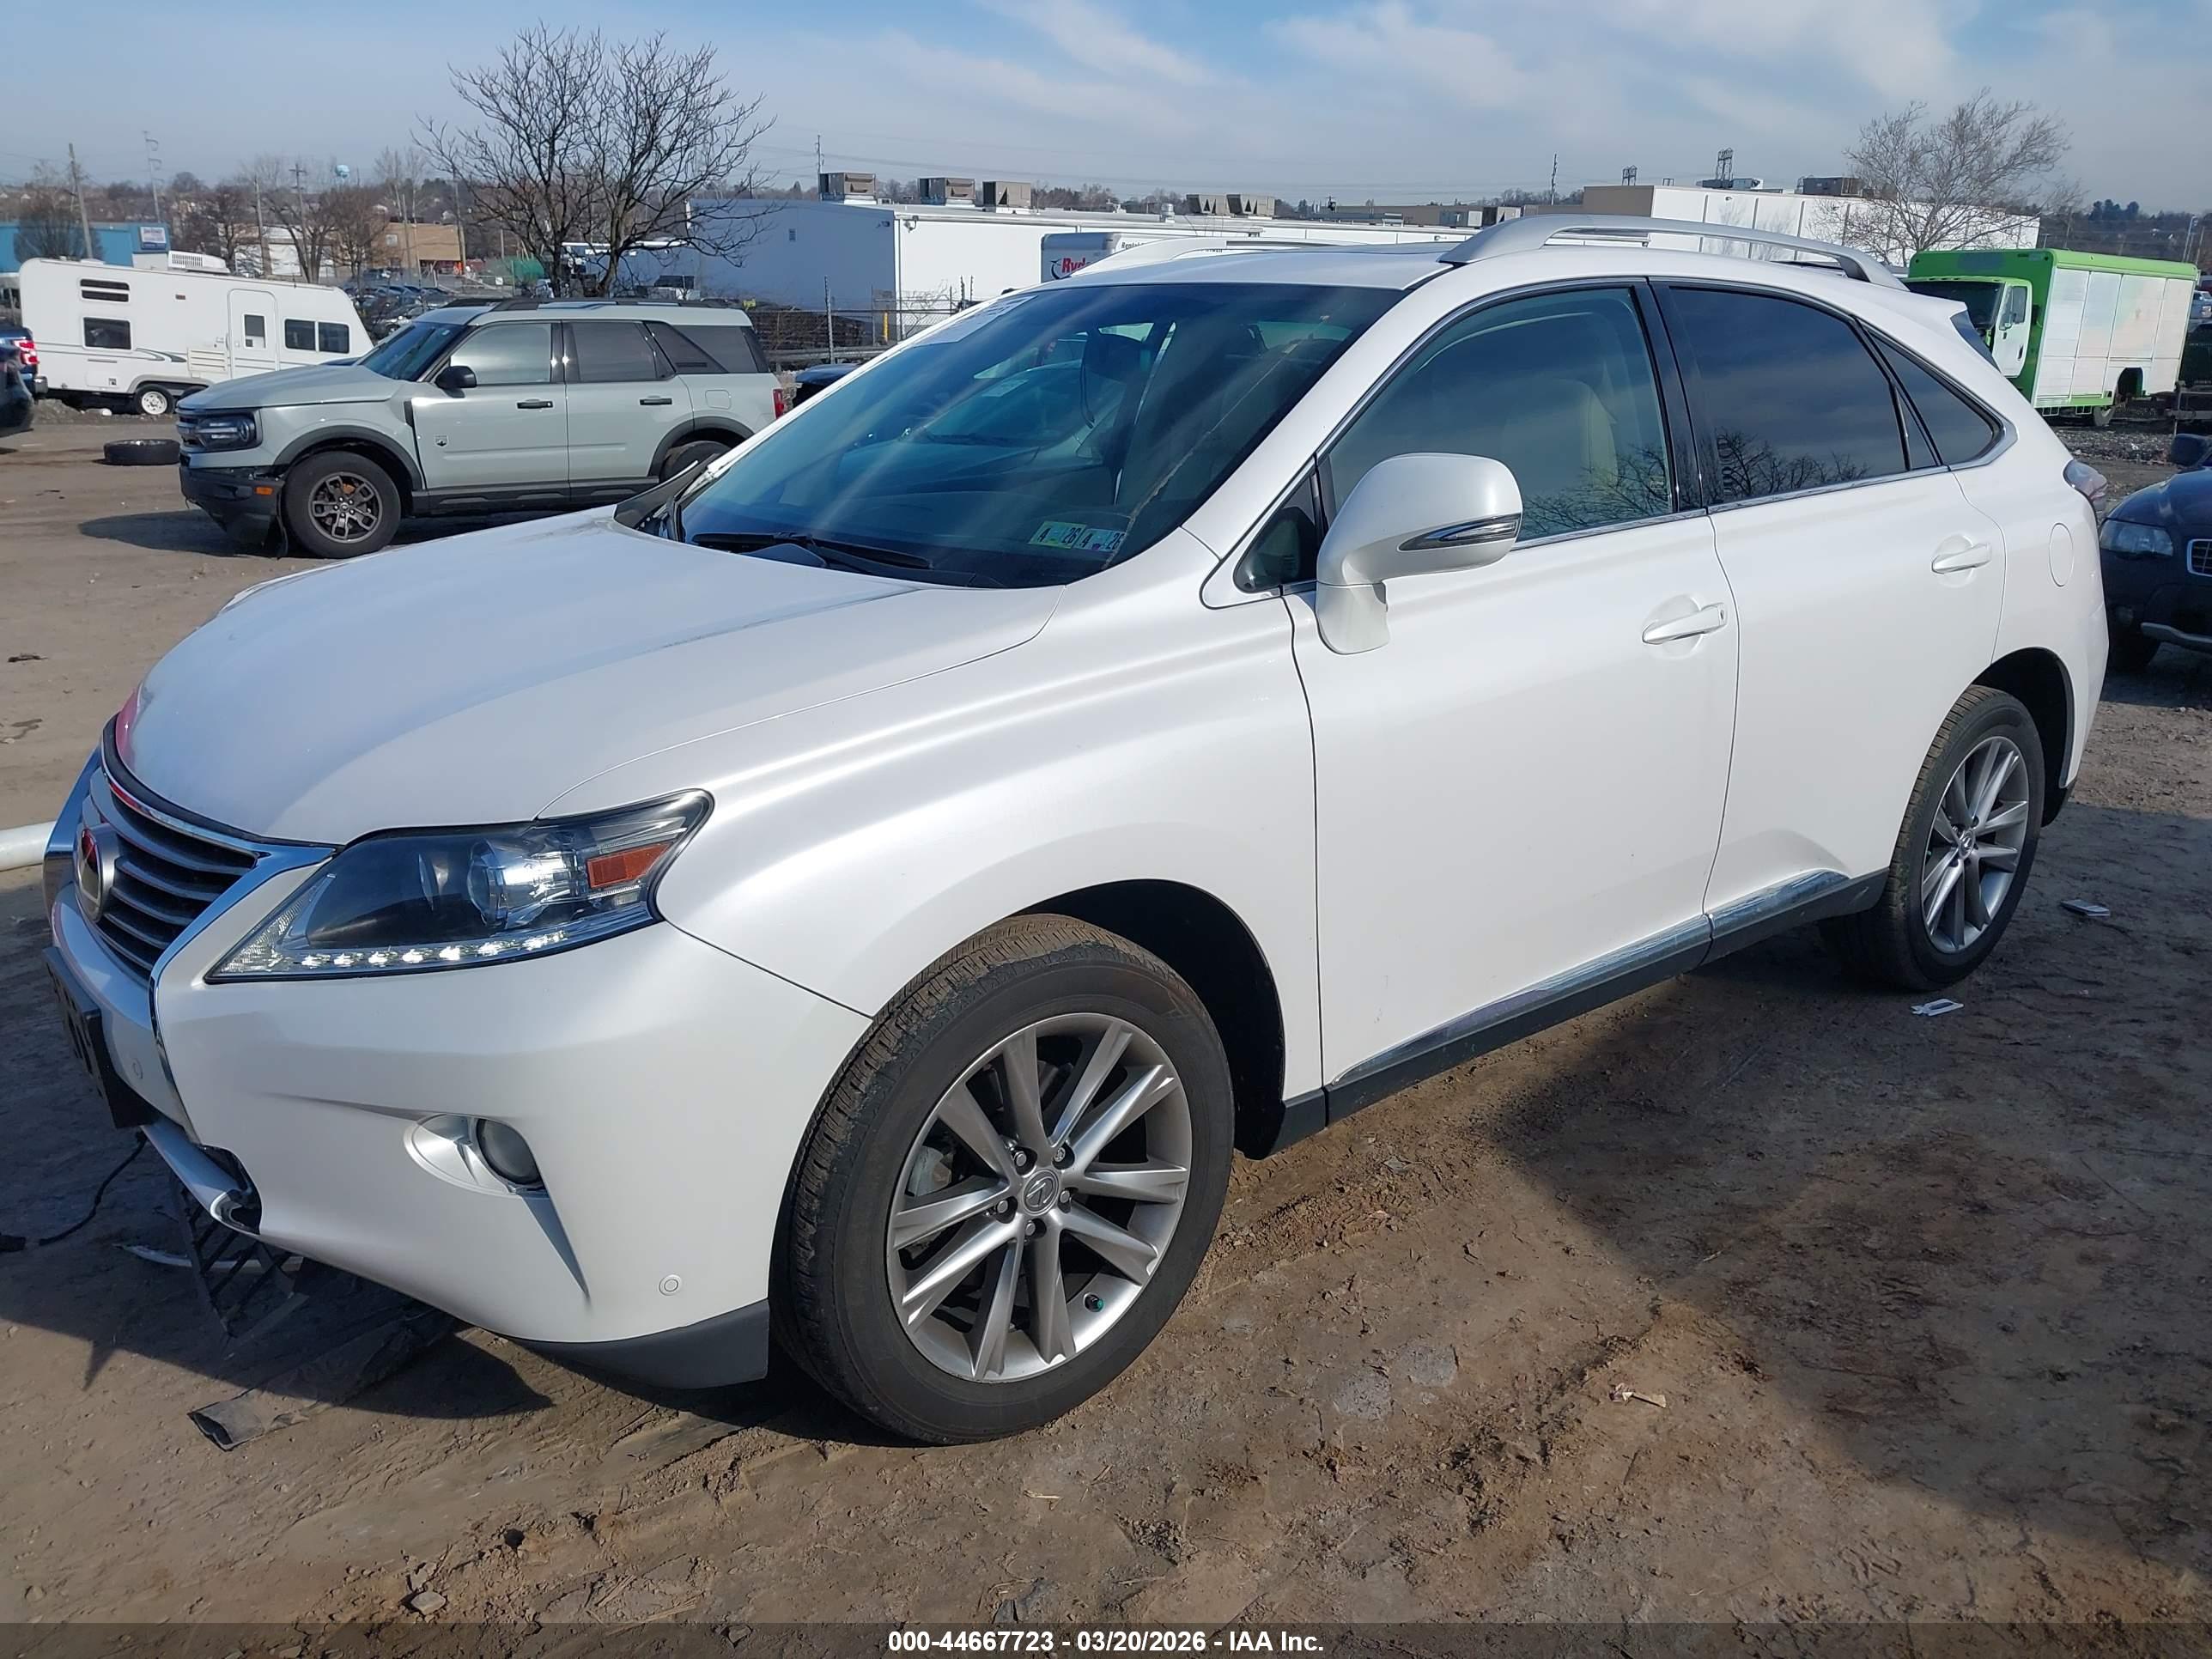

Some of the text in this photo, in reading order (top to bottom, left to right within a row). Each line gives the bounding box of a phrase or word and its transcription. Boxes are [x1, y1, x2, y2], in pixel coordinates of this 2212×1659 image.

[1061, 257, 1091, 273] Ryd
[1037, 527, 1052, 543] 4
[1079, 532, 1094, 548] 4
